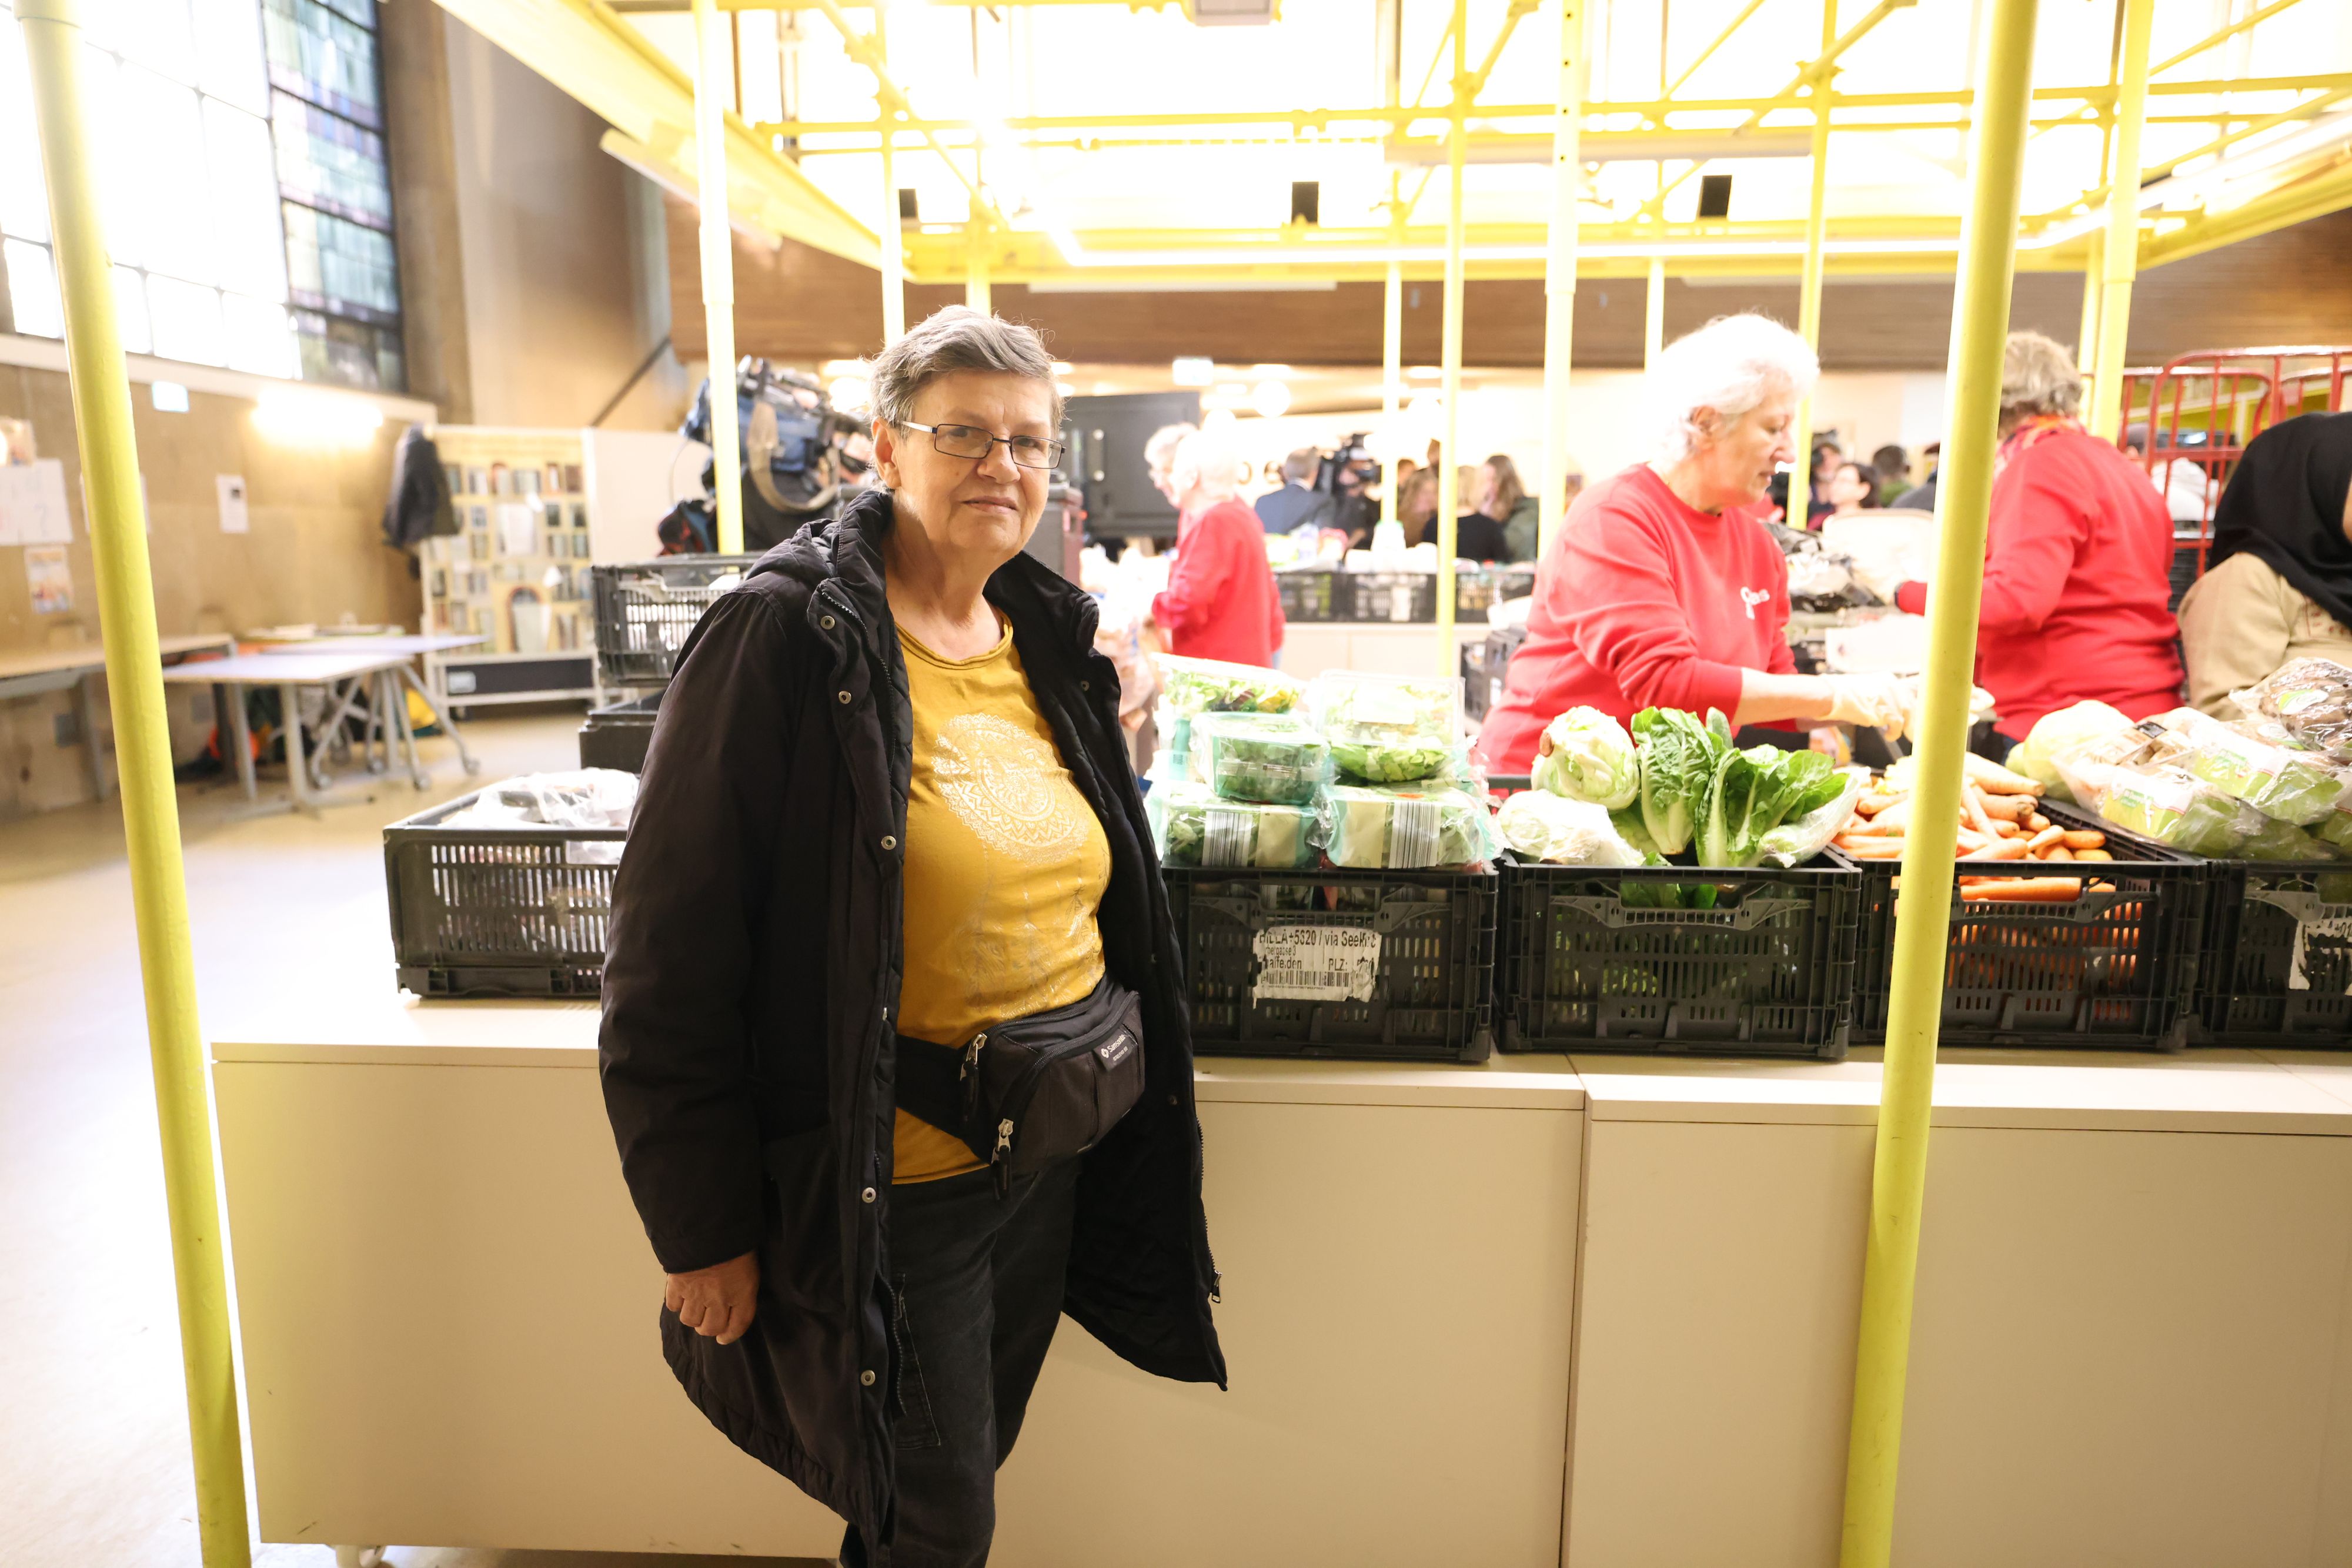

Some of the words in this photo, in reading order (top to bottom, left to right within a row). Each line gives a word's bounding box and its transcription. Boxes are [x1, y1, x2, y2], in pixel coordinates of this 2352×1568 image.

[1325, 931, 1338, 946] via
[1328, 958, 1348, 971] PLZ:
[1107, 1034, 1126, 1053] Samsonite
